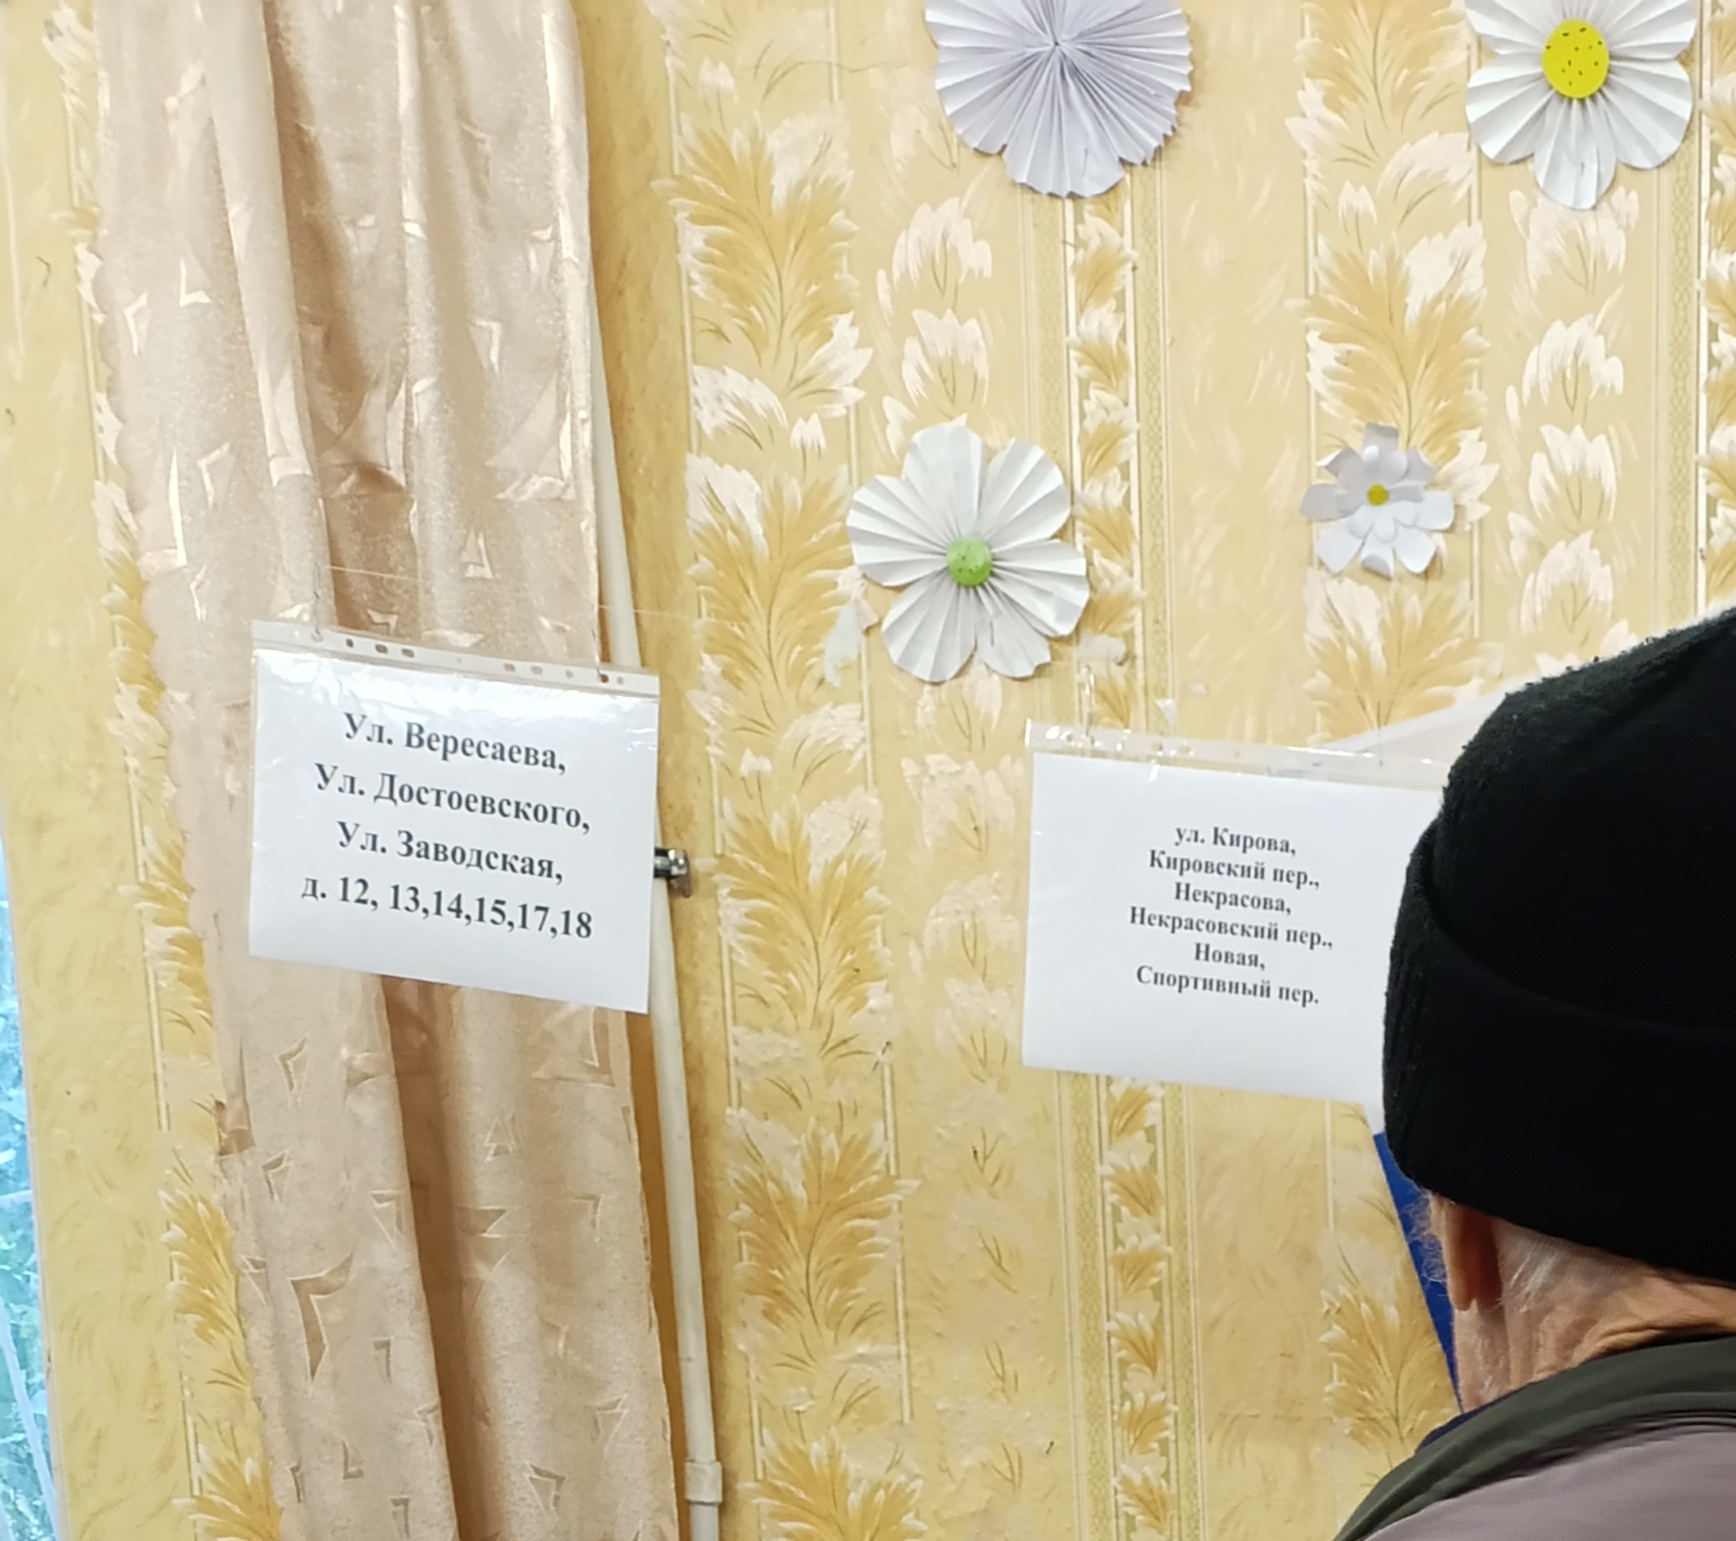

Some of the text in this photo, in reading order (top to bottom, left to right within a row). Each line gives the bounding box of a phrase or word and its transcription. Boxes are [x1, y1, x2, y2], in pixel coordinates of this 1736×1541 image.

[344, 712, 566, 775] Ул. Вересаева,
[315, 762, 590, 834] Ул. Достоевского,
[337, 820, 563, 885] Ул. Заводская,
[1174, 826, 1296, 856] ул. Кирова,
[1149, 849, 1320, 890] Кировский пер.,
[301, 876, 592, 939] д. 12, 13,14,15,17,18
[1174, 881, 1292, 915] Некрасова,
[1130, 907, 1333, 951] Некрасовский пер.,
[1194, 942, 1265, 971] Новая,
[1136, 963, 1319, 1008] Спортивный пер.
